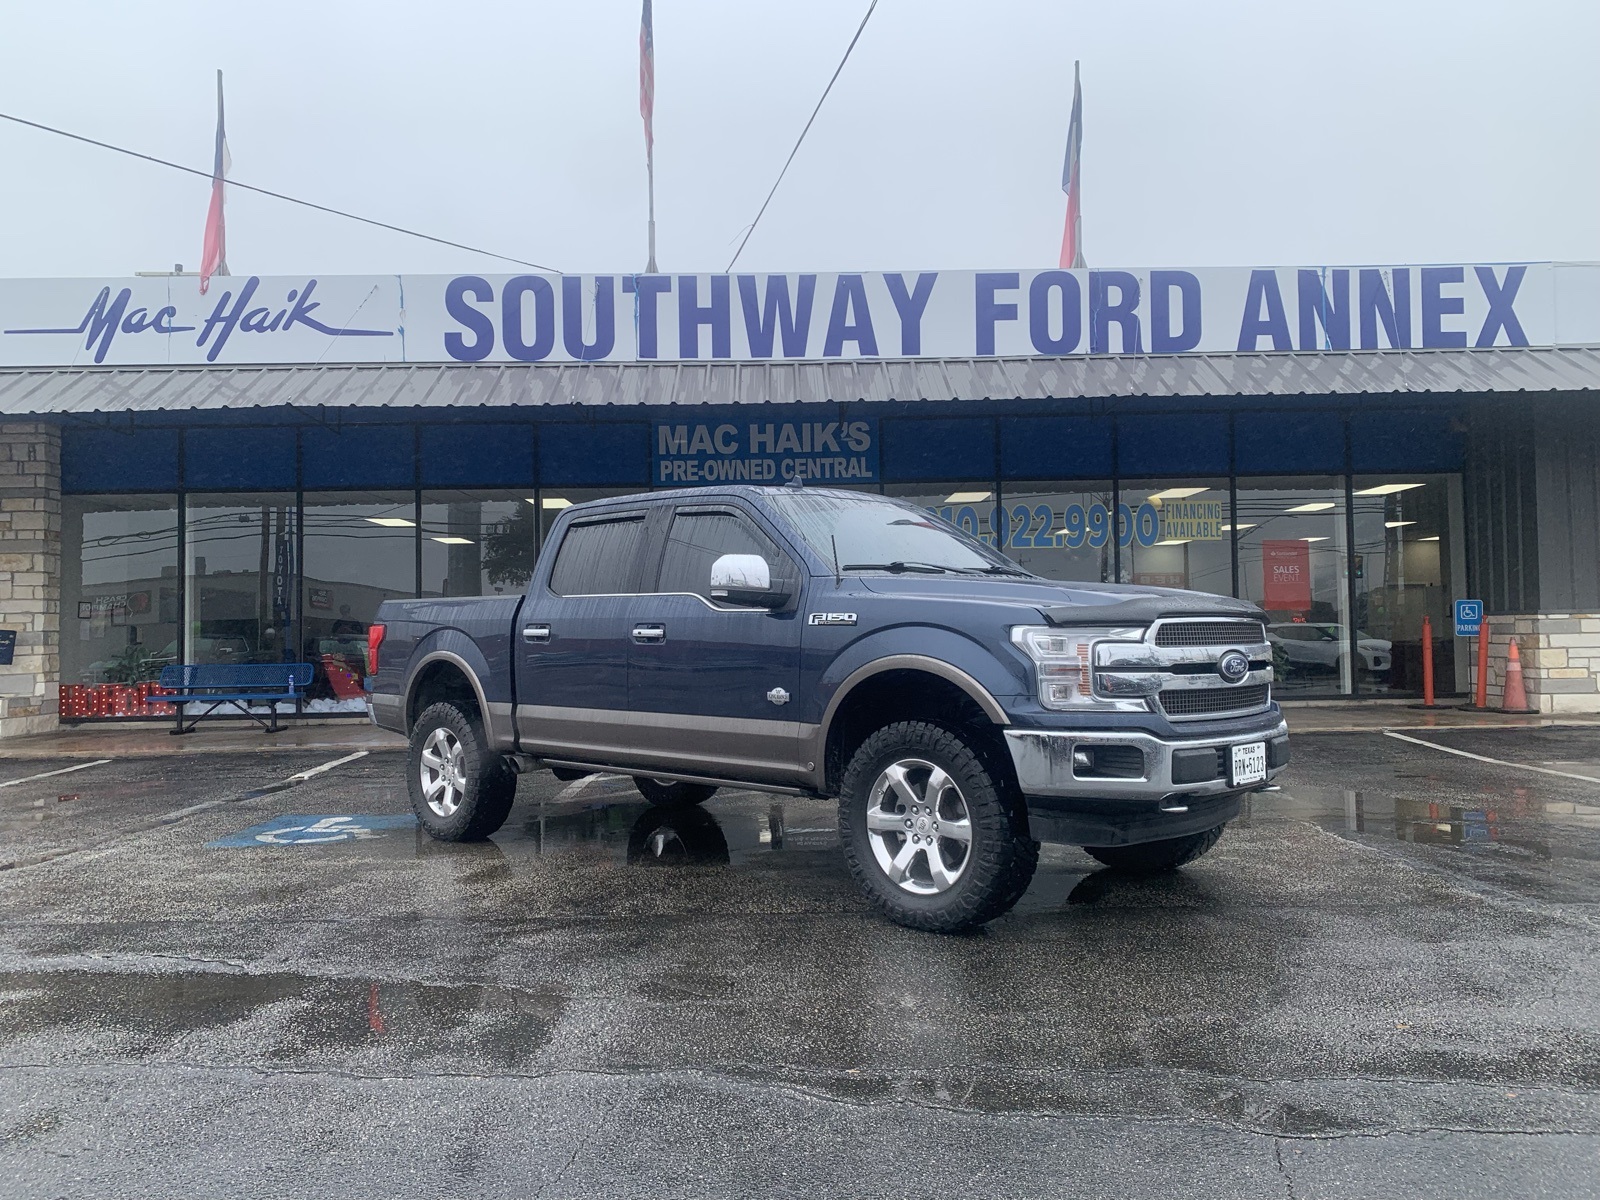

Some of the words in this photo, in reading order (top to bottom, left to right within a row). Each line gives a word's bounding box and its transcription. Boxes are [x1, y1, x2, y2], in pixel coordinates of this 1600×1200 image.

[4, 286, 196, 364] Mac
[196, 275, 394, 362] Haik
[444, 272, 939, 362] SOUTHWAY
[975, 270, 1202, 355] FORD
[1236, 266, 1530, 351] ANNEX
[658, 425, 739, 455] MAC
[750, 421, 871, 453] HAIK'S
[660, 459, 776, 481] PRE-OWNED
[781, 456, 873, 480] CENTRAL
[1165, 503, 1221, 520] FINANCING
[925, 502, 1160, 548] 0.922.9900
[1166, 521, 1222, 538] AVAILABLE
[1273, 565, 1300, 574] SALES
[1273, 574, 1300, 582] EVENT
[1229, 660, 1245, 673] Ford
[1242, 745, 1256, 756] TEXAS
